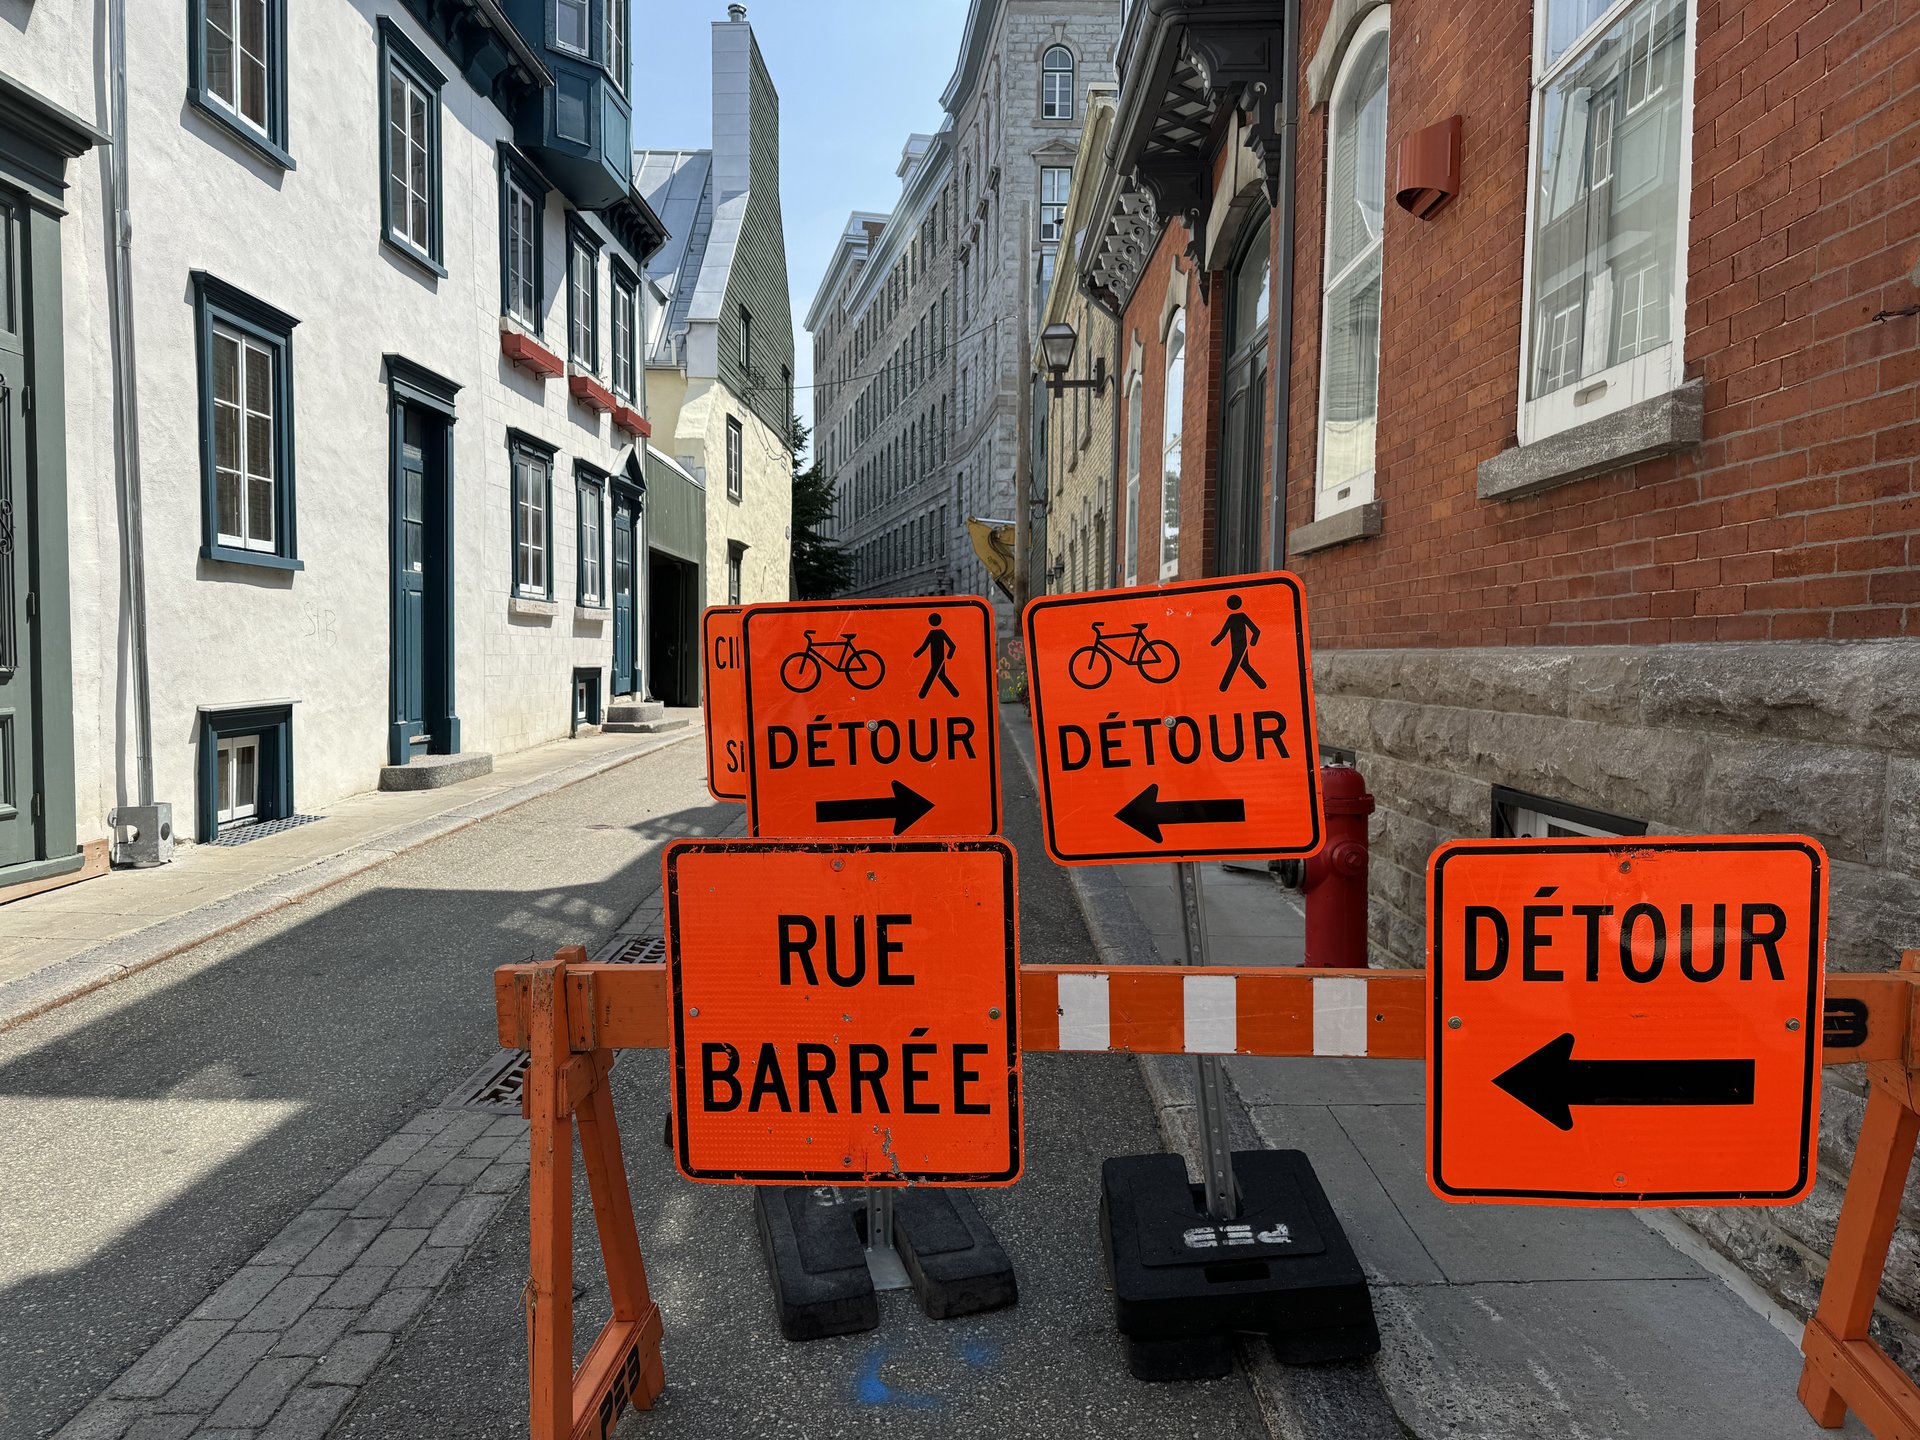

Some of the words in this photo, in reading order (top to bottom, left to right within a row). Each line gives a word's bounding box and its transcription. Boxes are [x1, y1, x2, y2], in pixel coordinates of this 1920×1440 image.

[767, 714, 977, 770] DÉTOUR
[1057, 710, 1291, 771] DÉTOUR
[777, 913, 915, 988] RUE
[1463, 886, 1788, 984] DÉTOUR
[700, 1027, 992, 1116] BARRÉE
